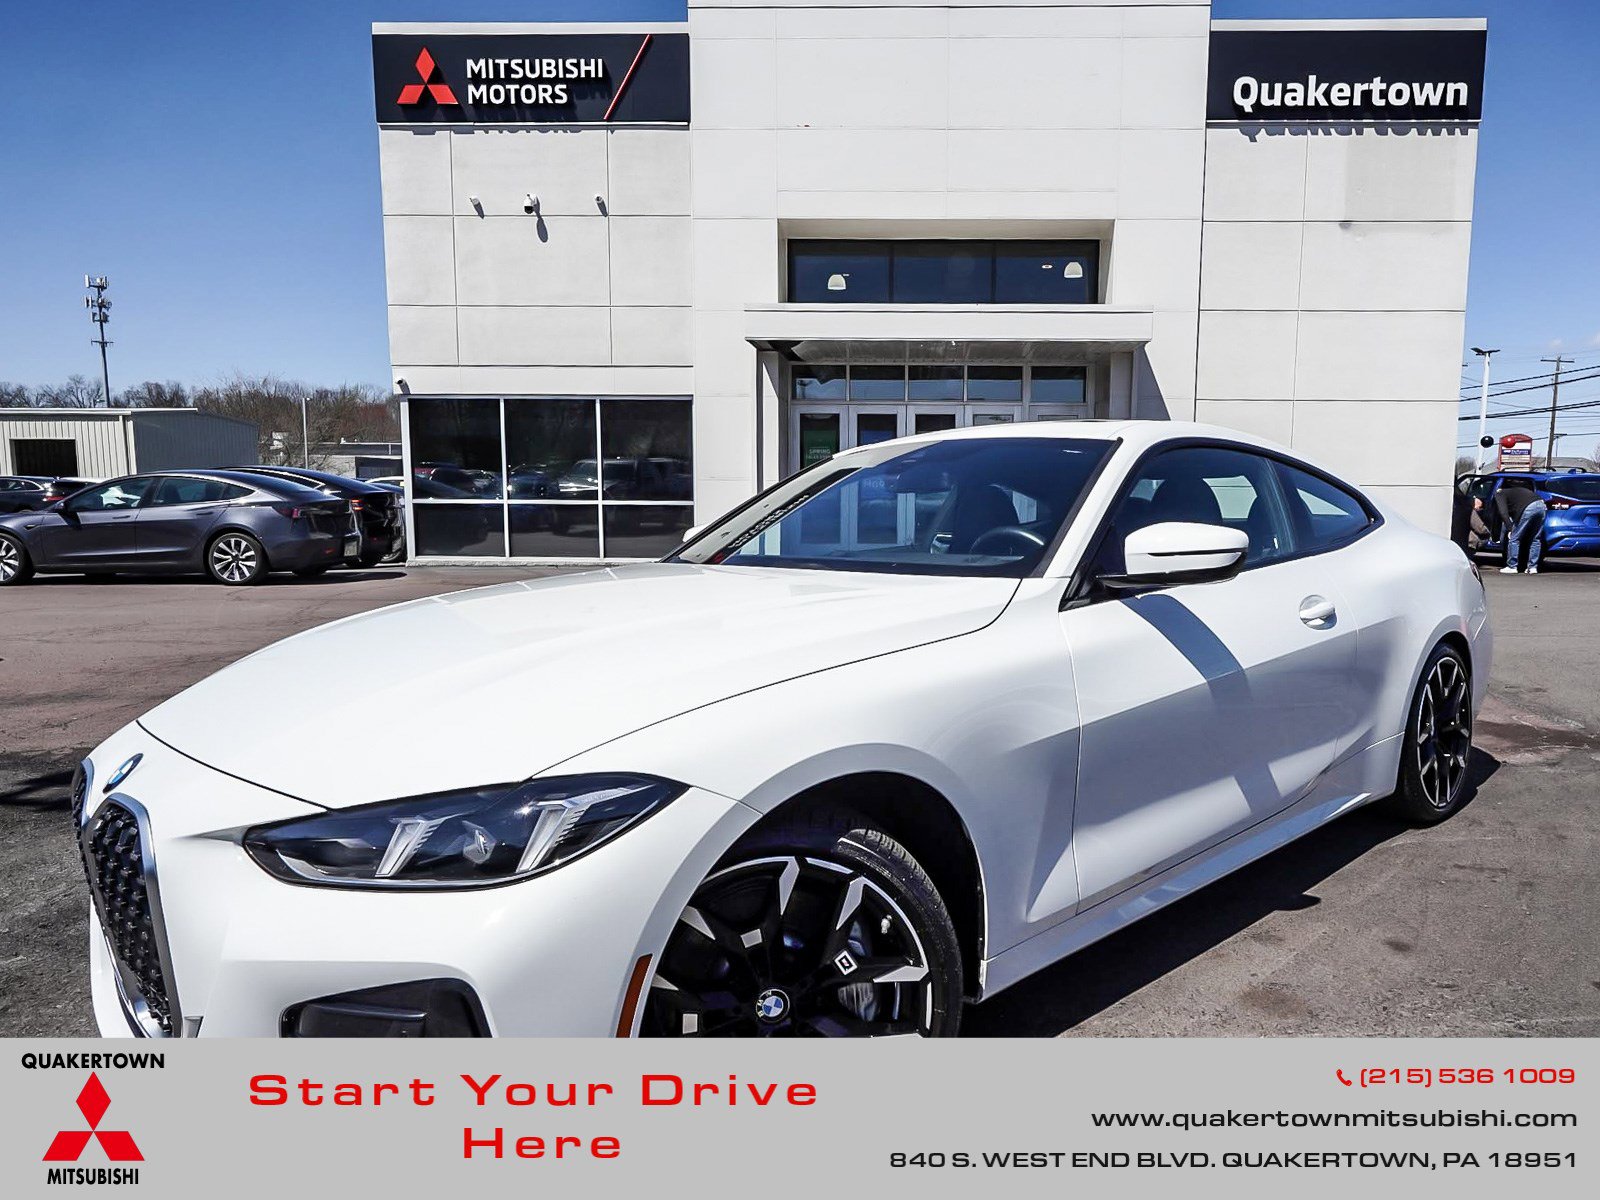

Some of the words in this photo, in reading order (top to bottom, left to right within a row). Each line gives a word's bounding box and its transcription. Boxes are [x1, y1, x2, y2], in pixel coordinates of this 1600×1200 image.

[466, 58, 603, 79] MITSUBISHI
[468, 84, 568, 105] MOTORS
[1233, 75, 1469, 113] Quakertown
